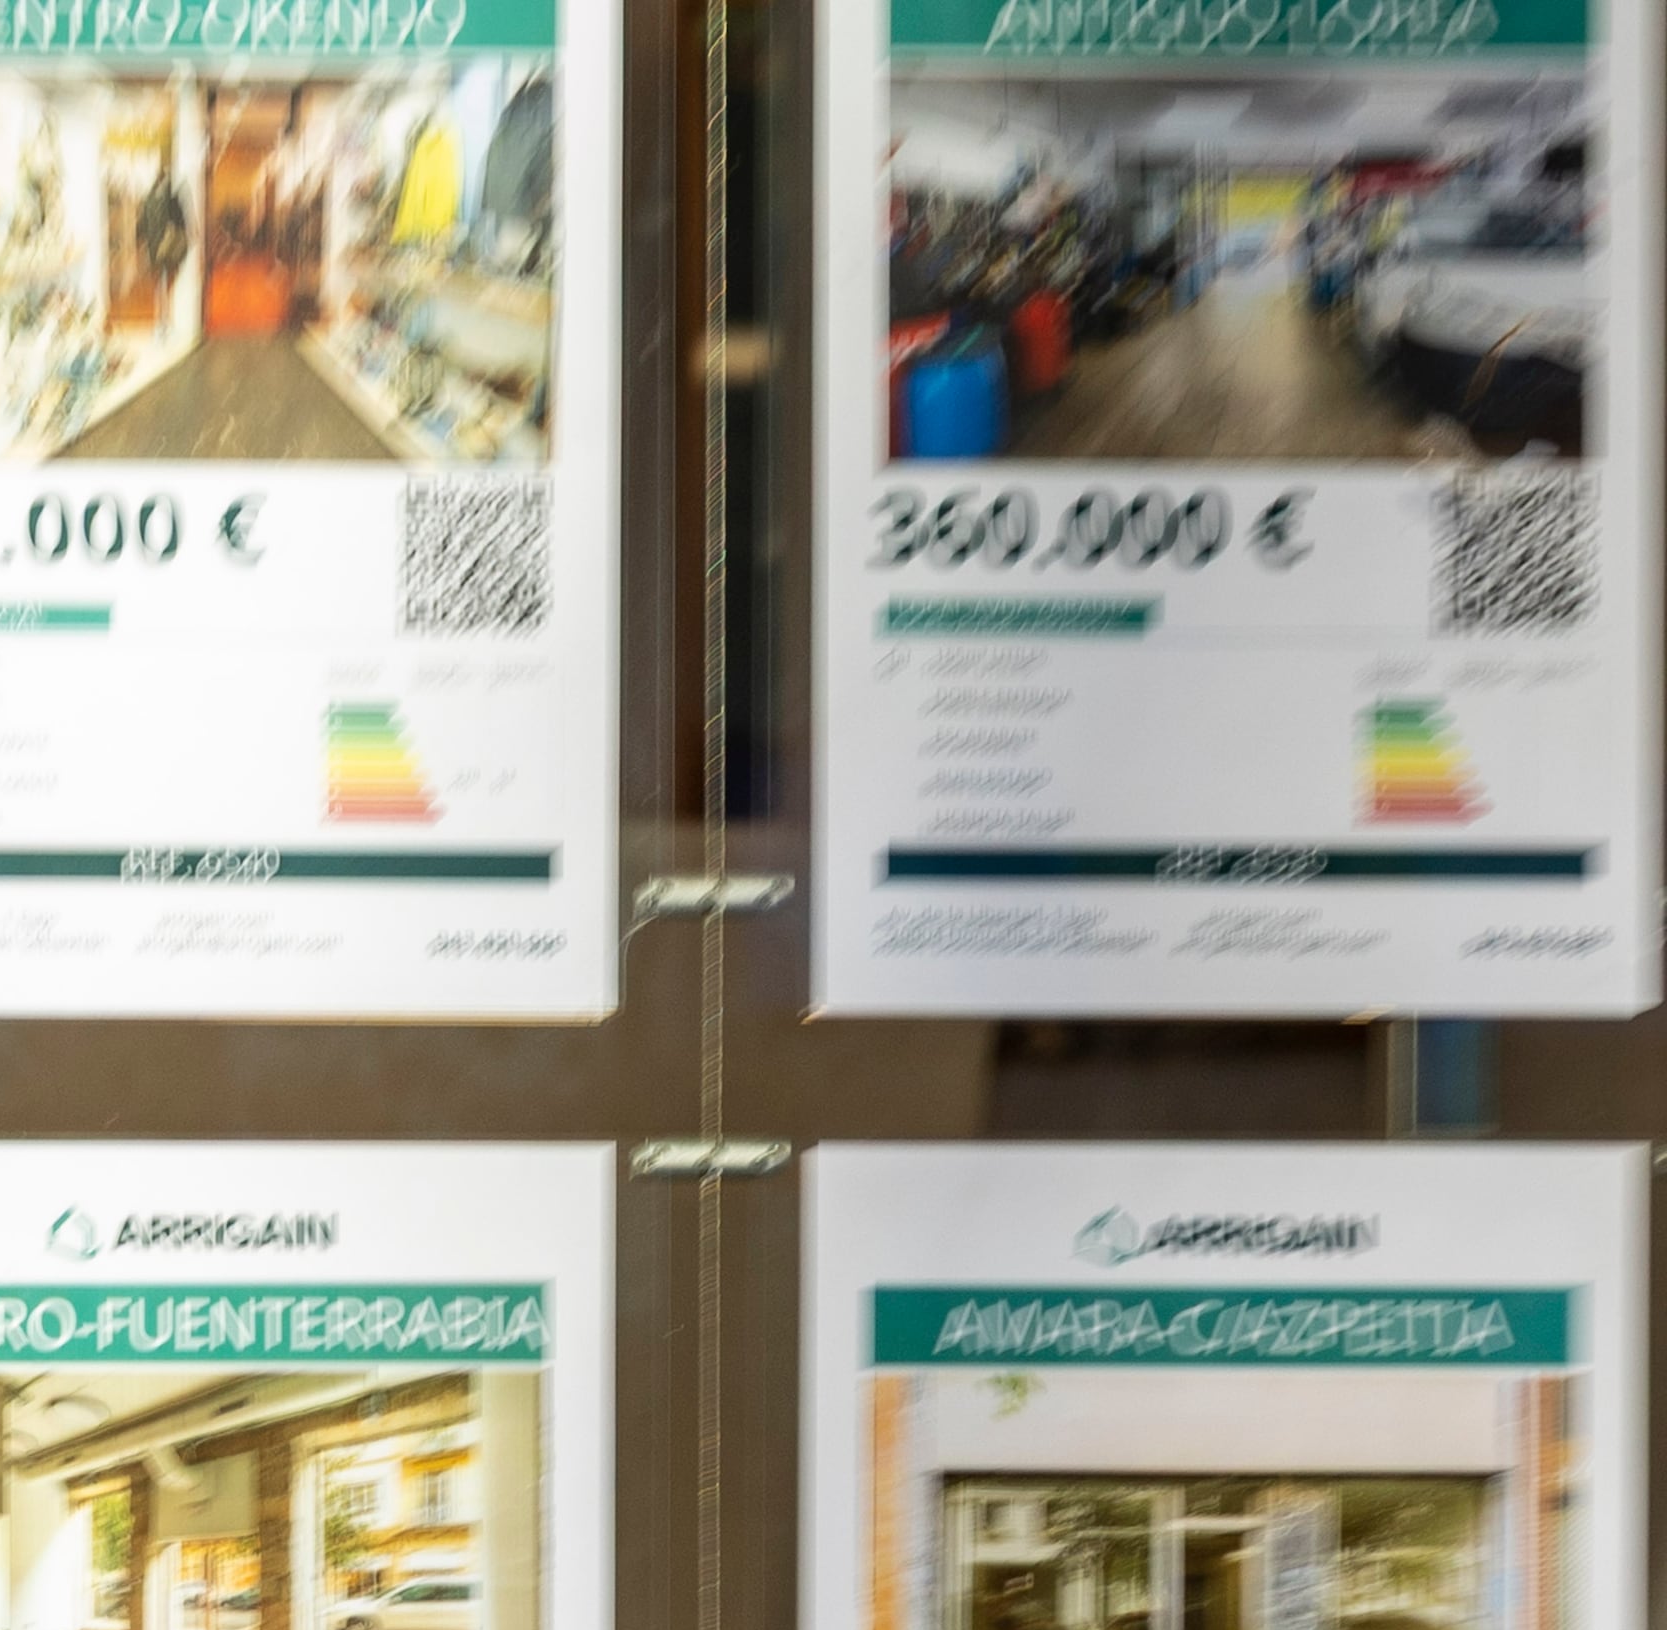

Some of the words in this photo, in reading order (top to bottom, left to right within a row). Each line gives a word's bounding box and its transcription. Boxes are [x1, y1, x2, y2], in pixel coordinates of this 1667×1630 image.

[216, 489, 268, 566] €
[870, 486, 1234, 570] 360.000
[1247, 486, 1316, 570] €
[112, 1212, 339, 1252] ARRIGAIN
